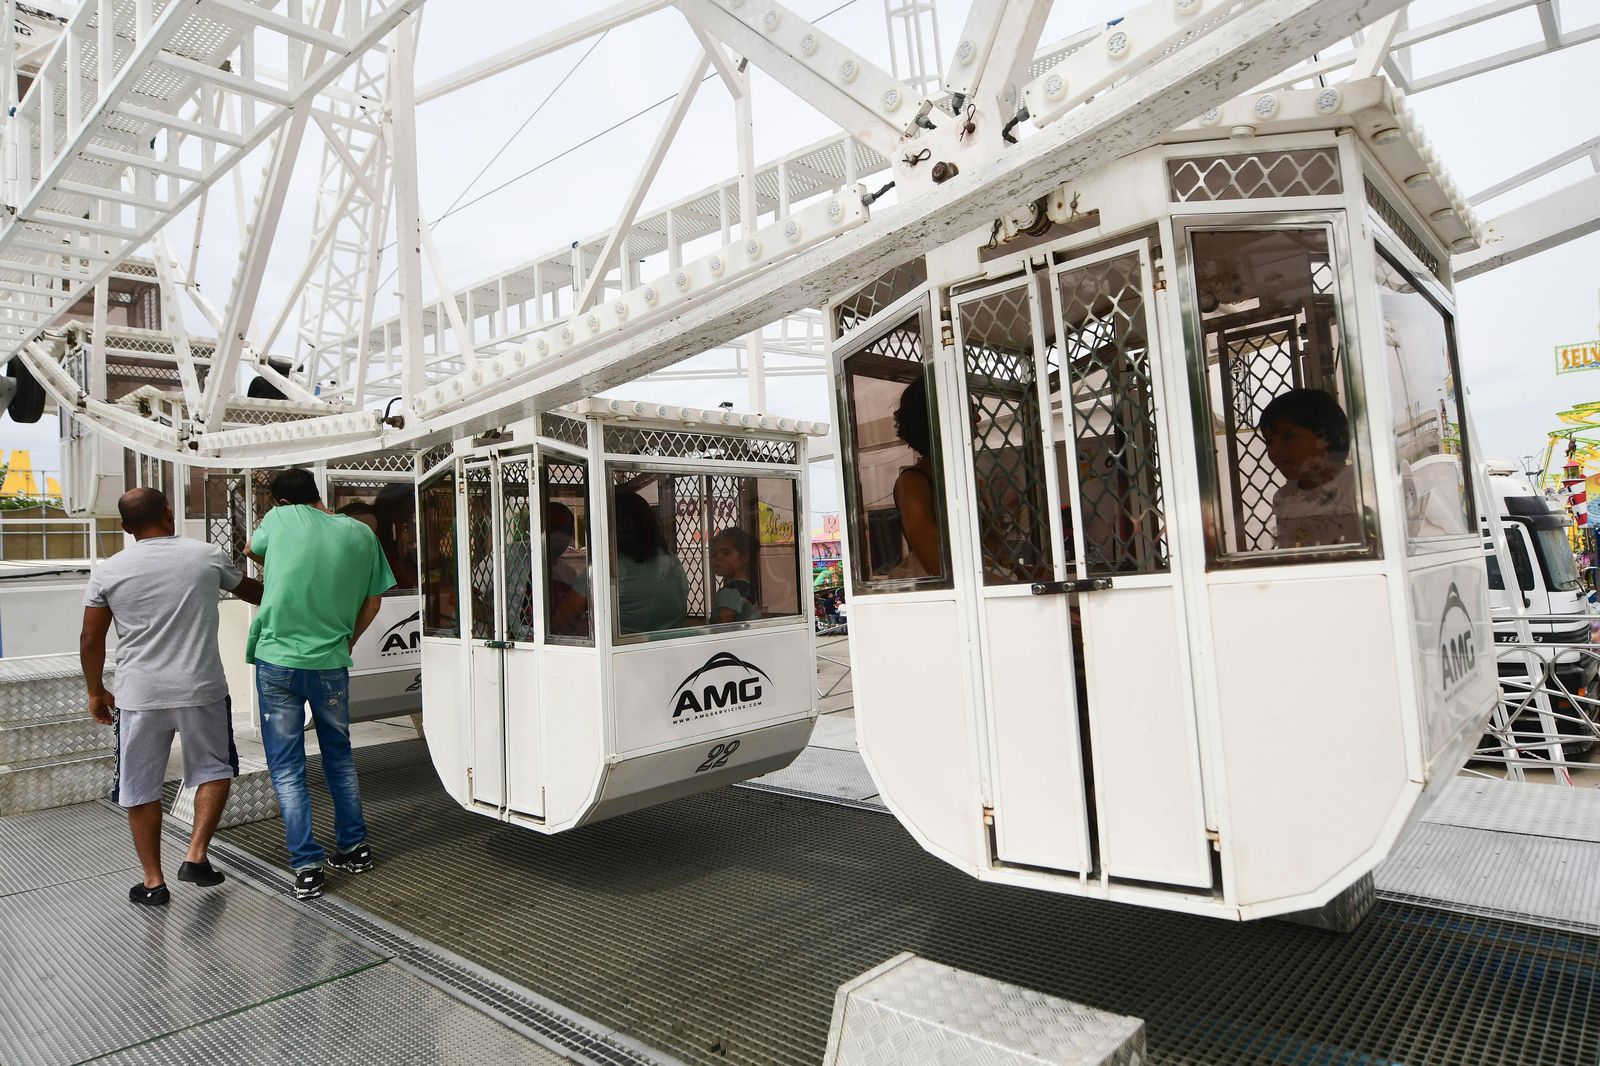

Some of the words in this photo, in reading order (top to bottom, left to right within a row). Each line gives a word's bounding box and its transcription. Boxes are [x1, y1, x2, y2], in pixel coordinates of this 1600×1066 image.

[1501, 635, 1544, 643] 183
[1442, 629, 1476, 691] AMG
[672, 676, 762, 718] AMG
[672, 701, 763, 725] WWW.AMGSERVICIOS.COM
[694, 739, 741, 774] 22
